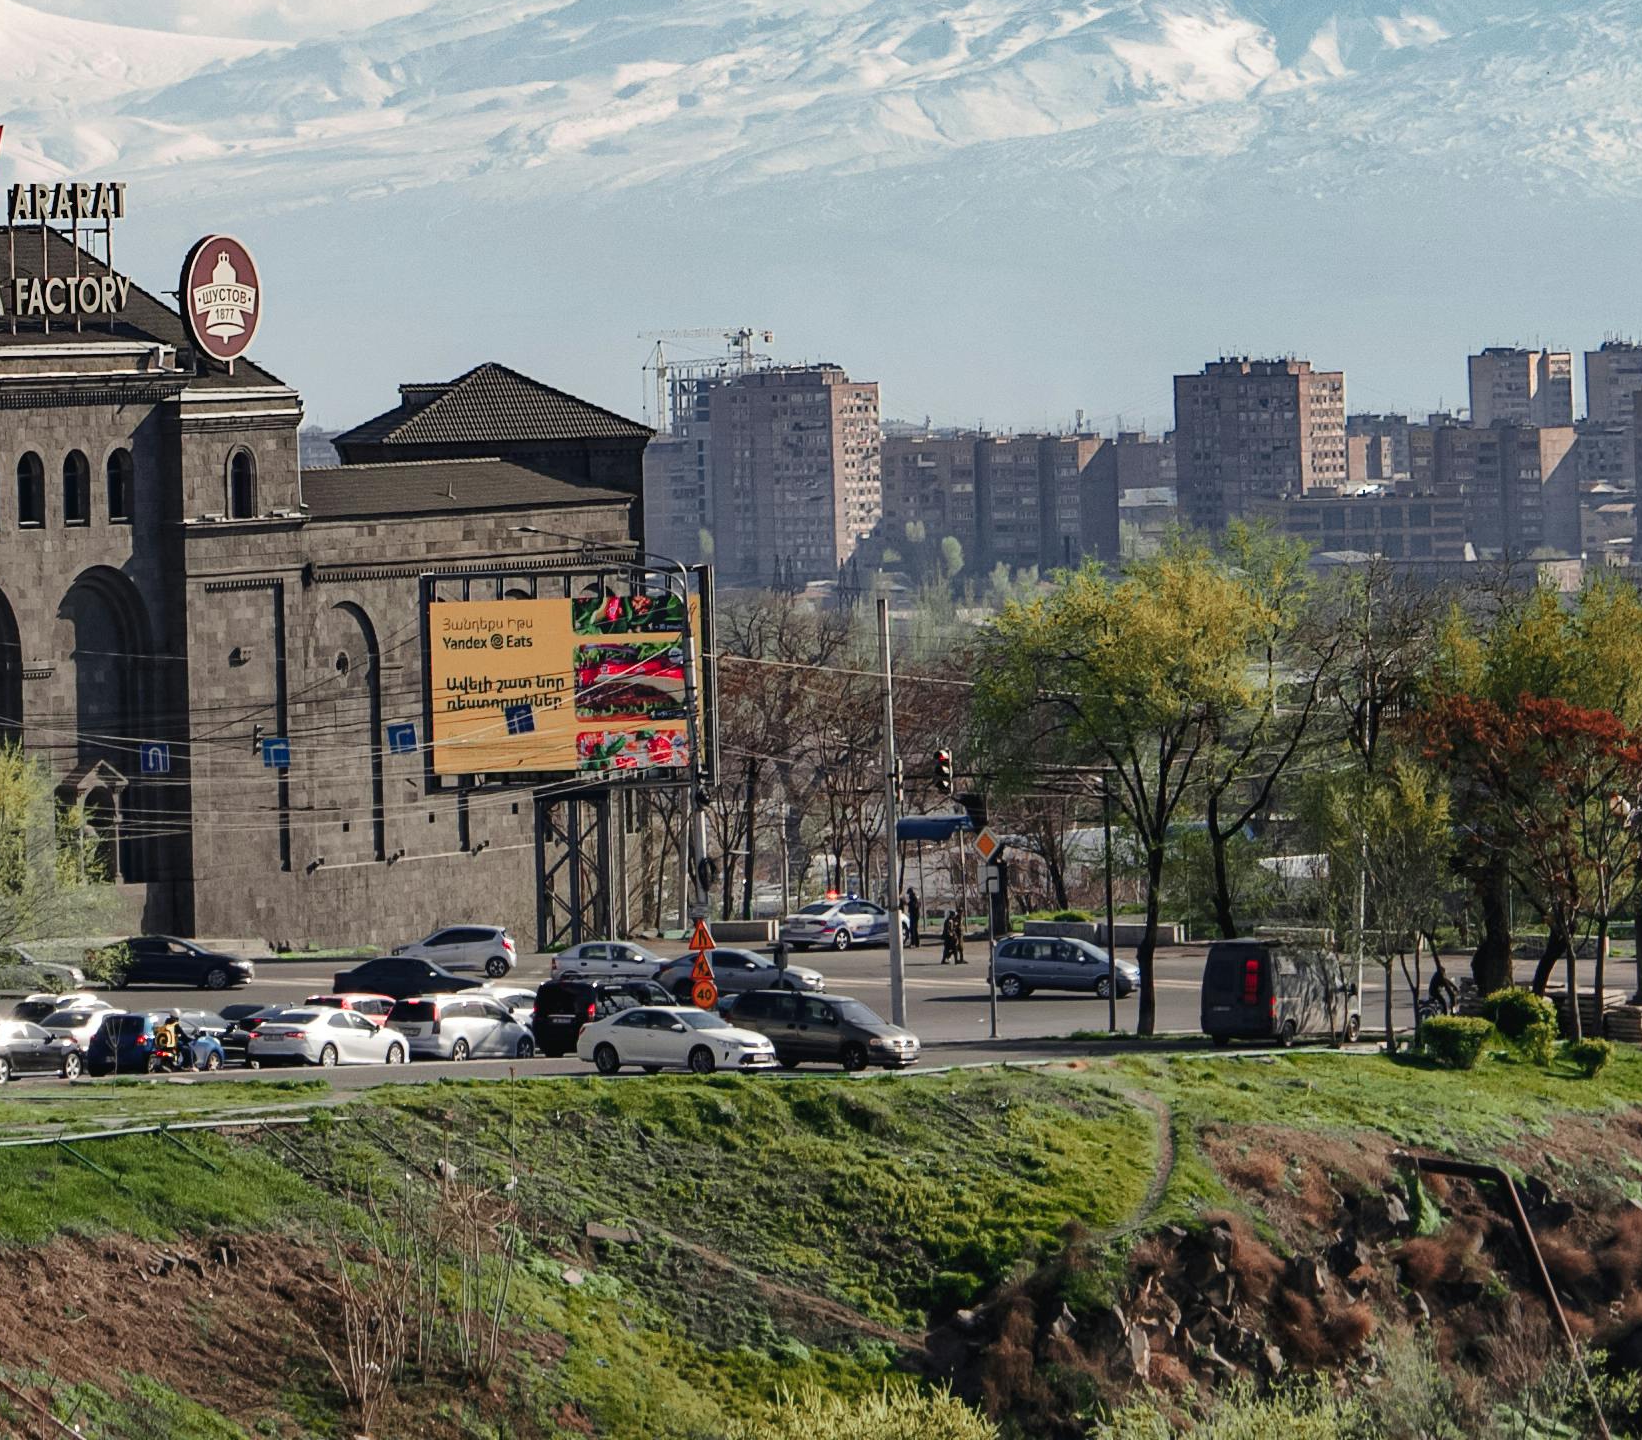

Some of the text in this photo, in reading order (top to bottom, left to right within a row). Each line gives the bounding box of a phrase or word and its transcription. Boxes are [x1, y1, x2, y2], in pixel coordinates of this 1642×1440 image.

[11, 182, 127, 220] ARARAT
[14, 275, 131, 316] FACTORY
[202, 288, 247, 305] ШУСТОВ
[215, 308, 235, 321] 1877
[442, 635, 533, 650] Yandex Eats
[446, 675, 564, 694] Ավելի շատ նոր
[697, 989, 712, 1001] 40
